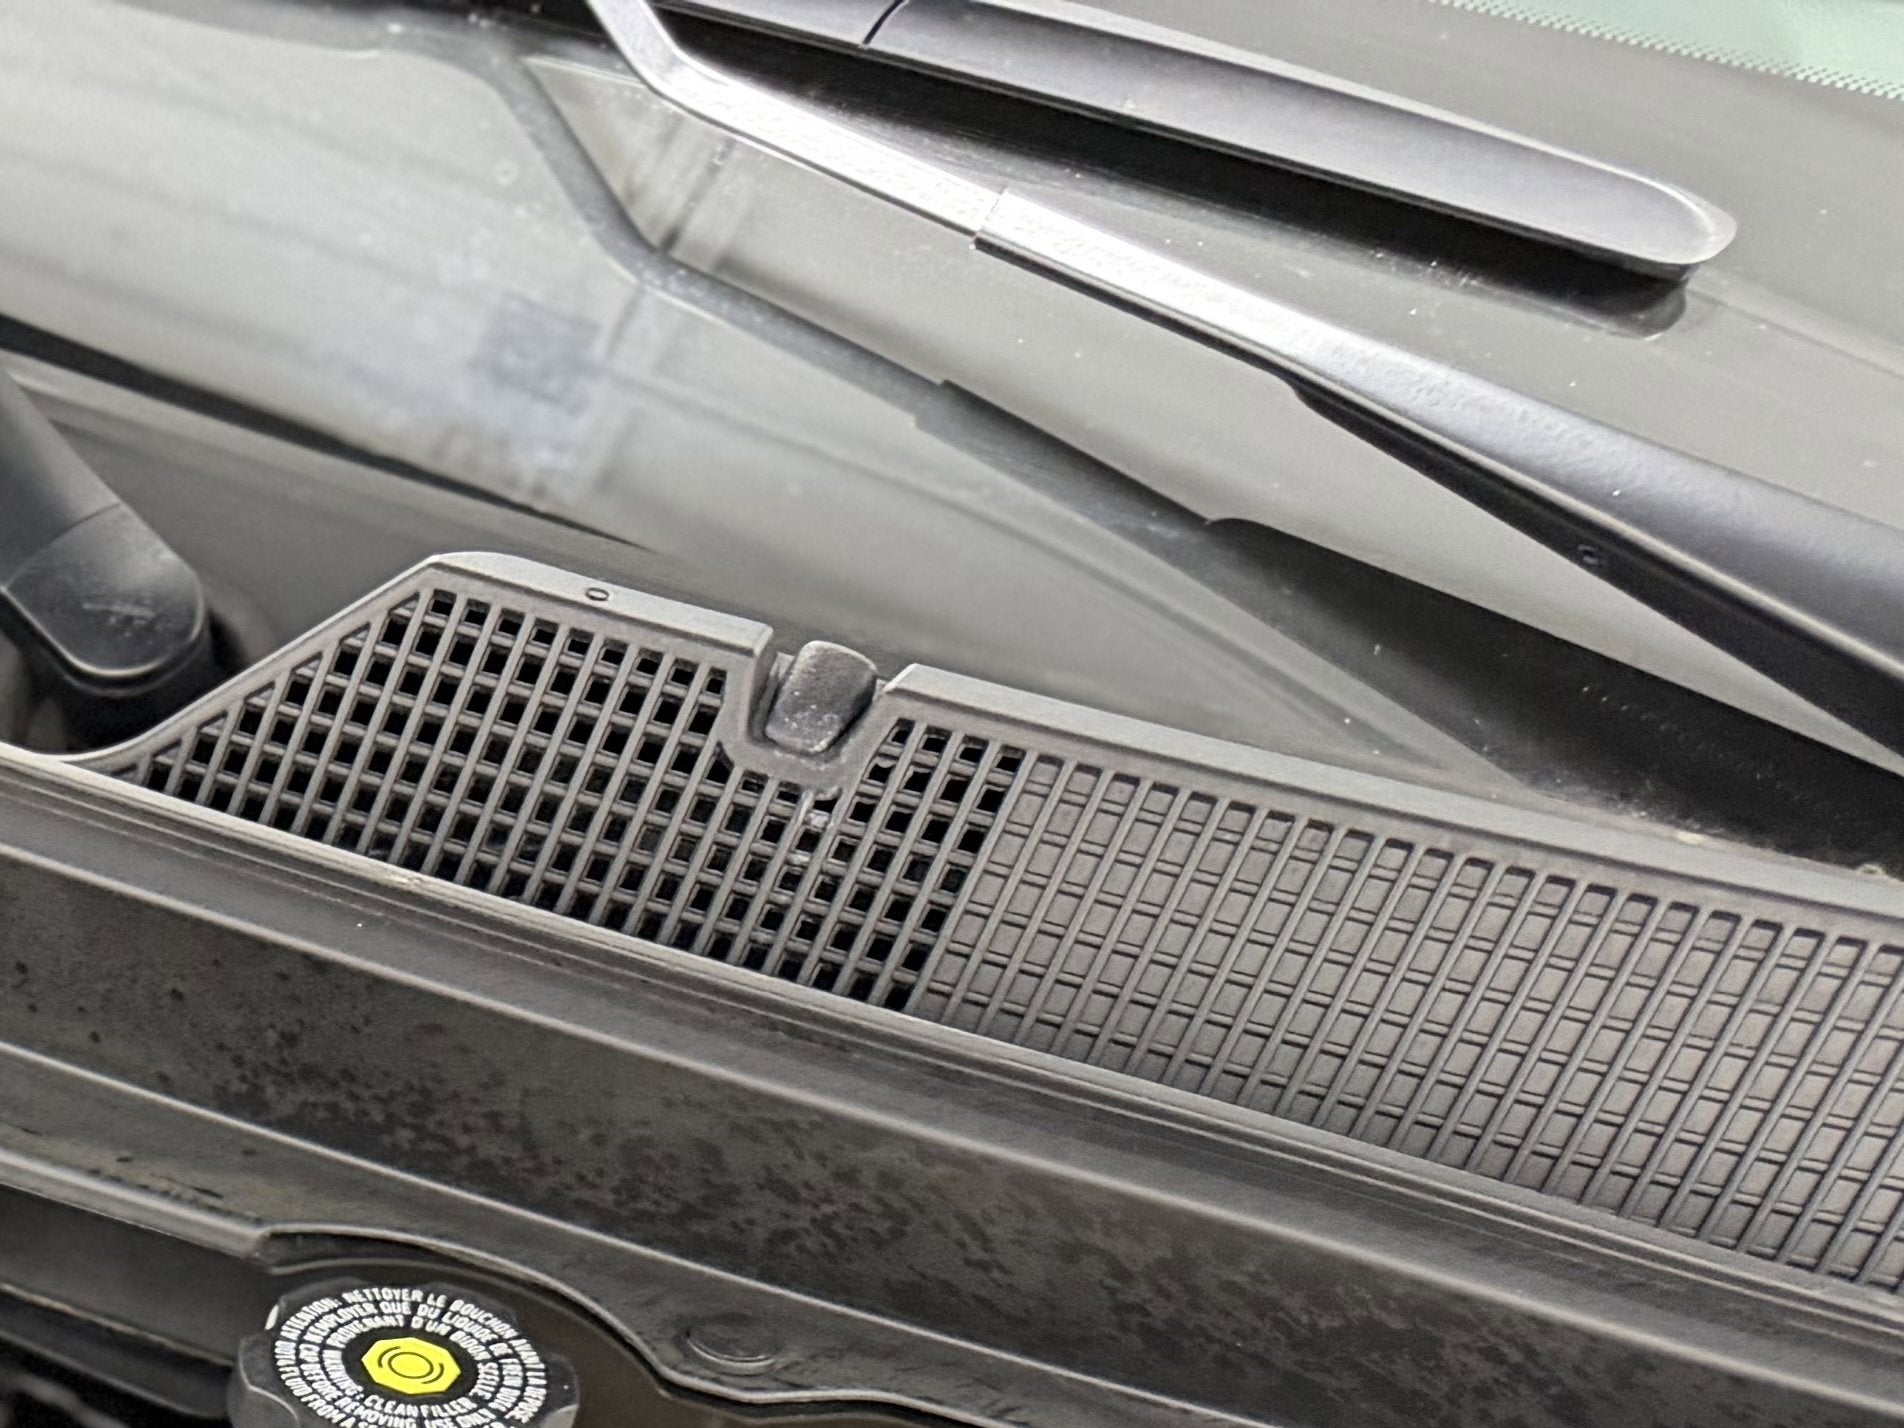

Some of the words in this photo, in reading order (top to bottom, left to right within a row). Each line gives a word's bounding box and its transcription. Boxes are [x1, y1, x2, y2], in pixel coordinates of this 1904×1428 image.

[337, 1286, 423, 1304] NETTOYER
[376, 1300, 411, 1315] QUE
[426, 1291, 448, 1307] LE
[416, 1303, 441, 1319] DU
[448, 1298, 521, 1339] BOUCHON
[322, 1314, 405, 1349] PROVENANT
[446, 1329, 495, 1360] BIDON
[440, 1310, 499, 1343] LIQUIDE
[298, 1342, 321, 1361] CAP
[486, 1341, 513, 1356] DE
[506, 1337, 546, 1368] AVANT
[299, 1363, 345, 1402] BEFORE
[495, 1357, 523, 1388] FREIN
[525, 1371, 546, 1386] LA
[276, 1366, 314, 1397] FLUID
[298, 1393, 347, 1424] FROM
[338, 1415, 358, 1428] A
[360, 1393, 419, 1419] CLEAN
[419, 1395, 481, 1419] FILLER
